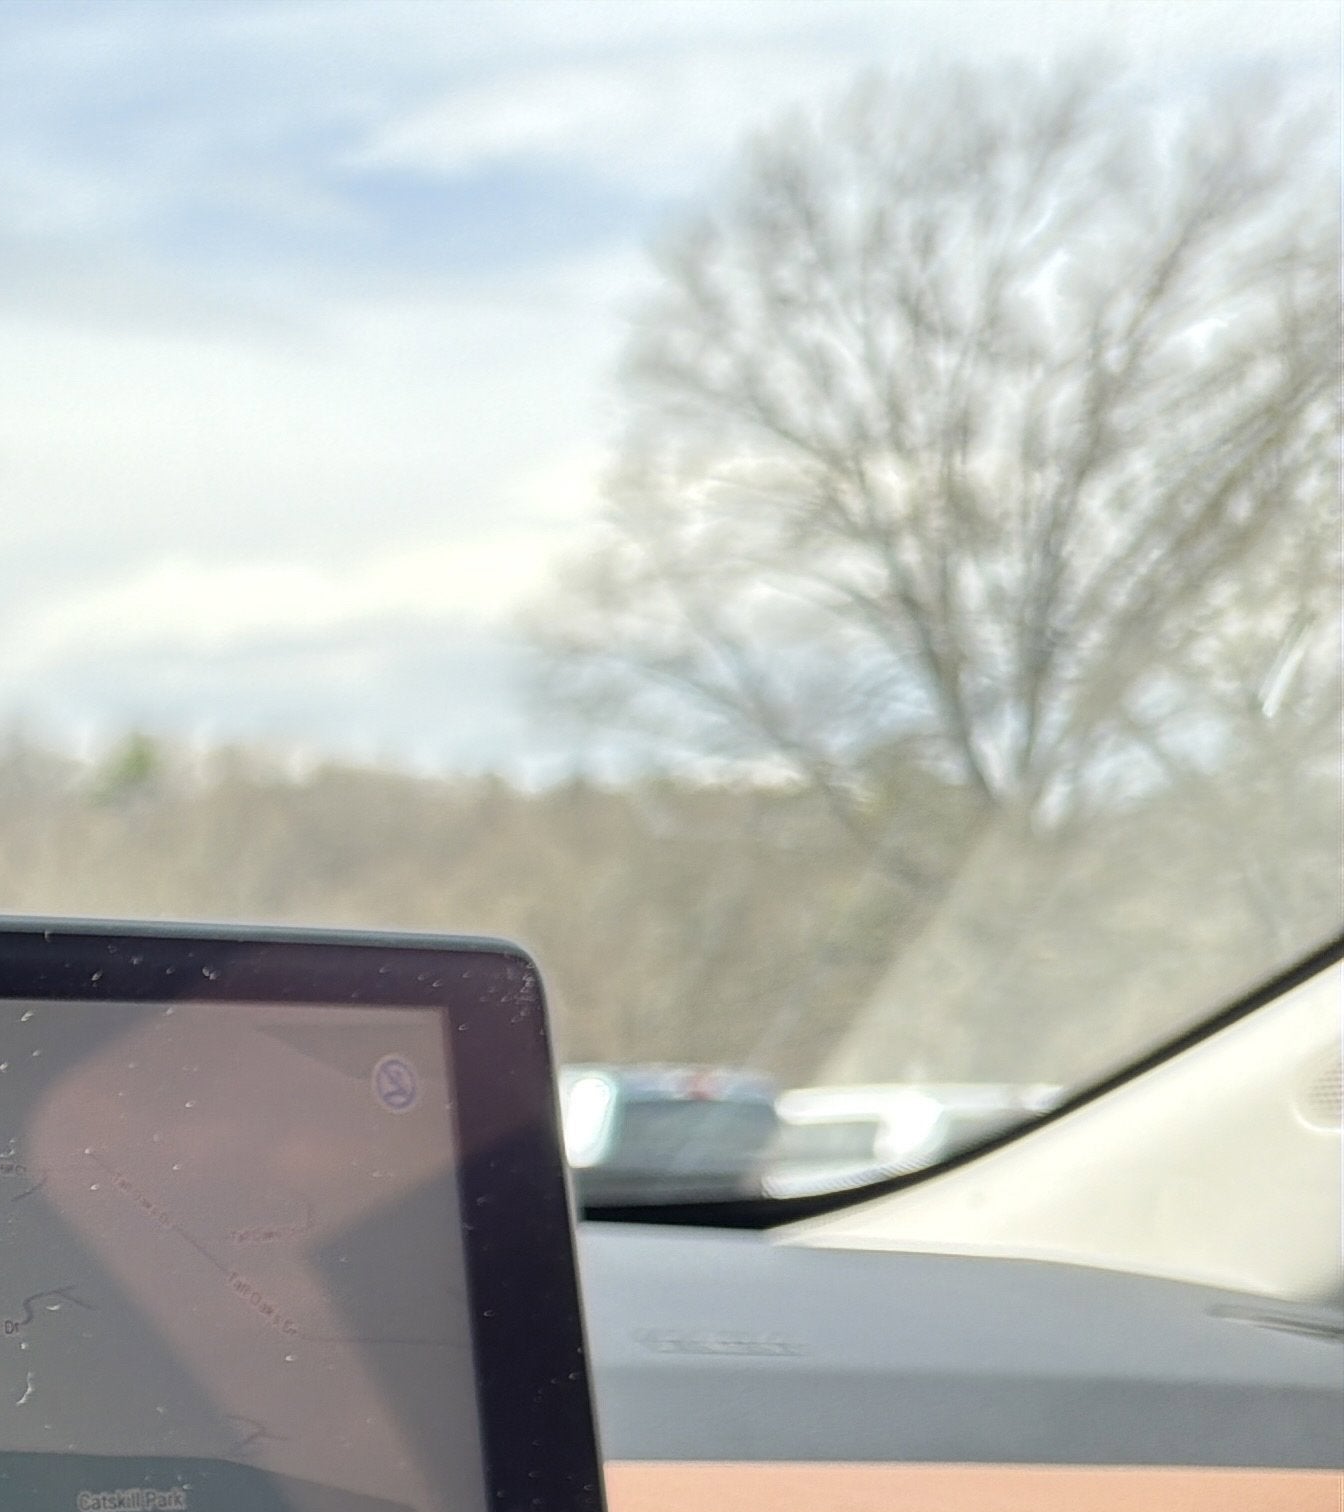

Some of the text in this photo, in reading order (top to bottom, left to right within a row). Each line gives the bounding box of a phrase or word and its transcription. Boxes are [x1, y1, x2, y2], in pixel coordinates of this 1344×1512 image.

[3, 1319, 21, 1336] Dr
[78, 1487, 185, 1511] Catskill Park
